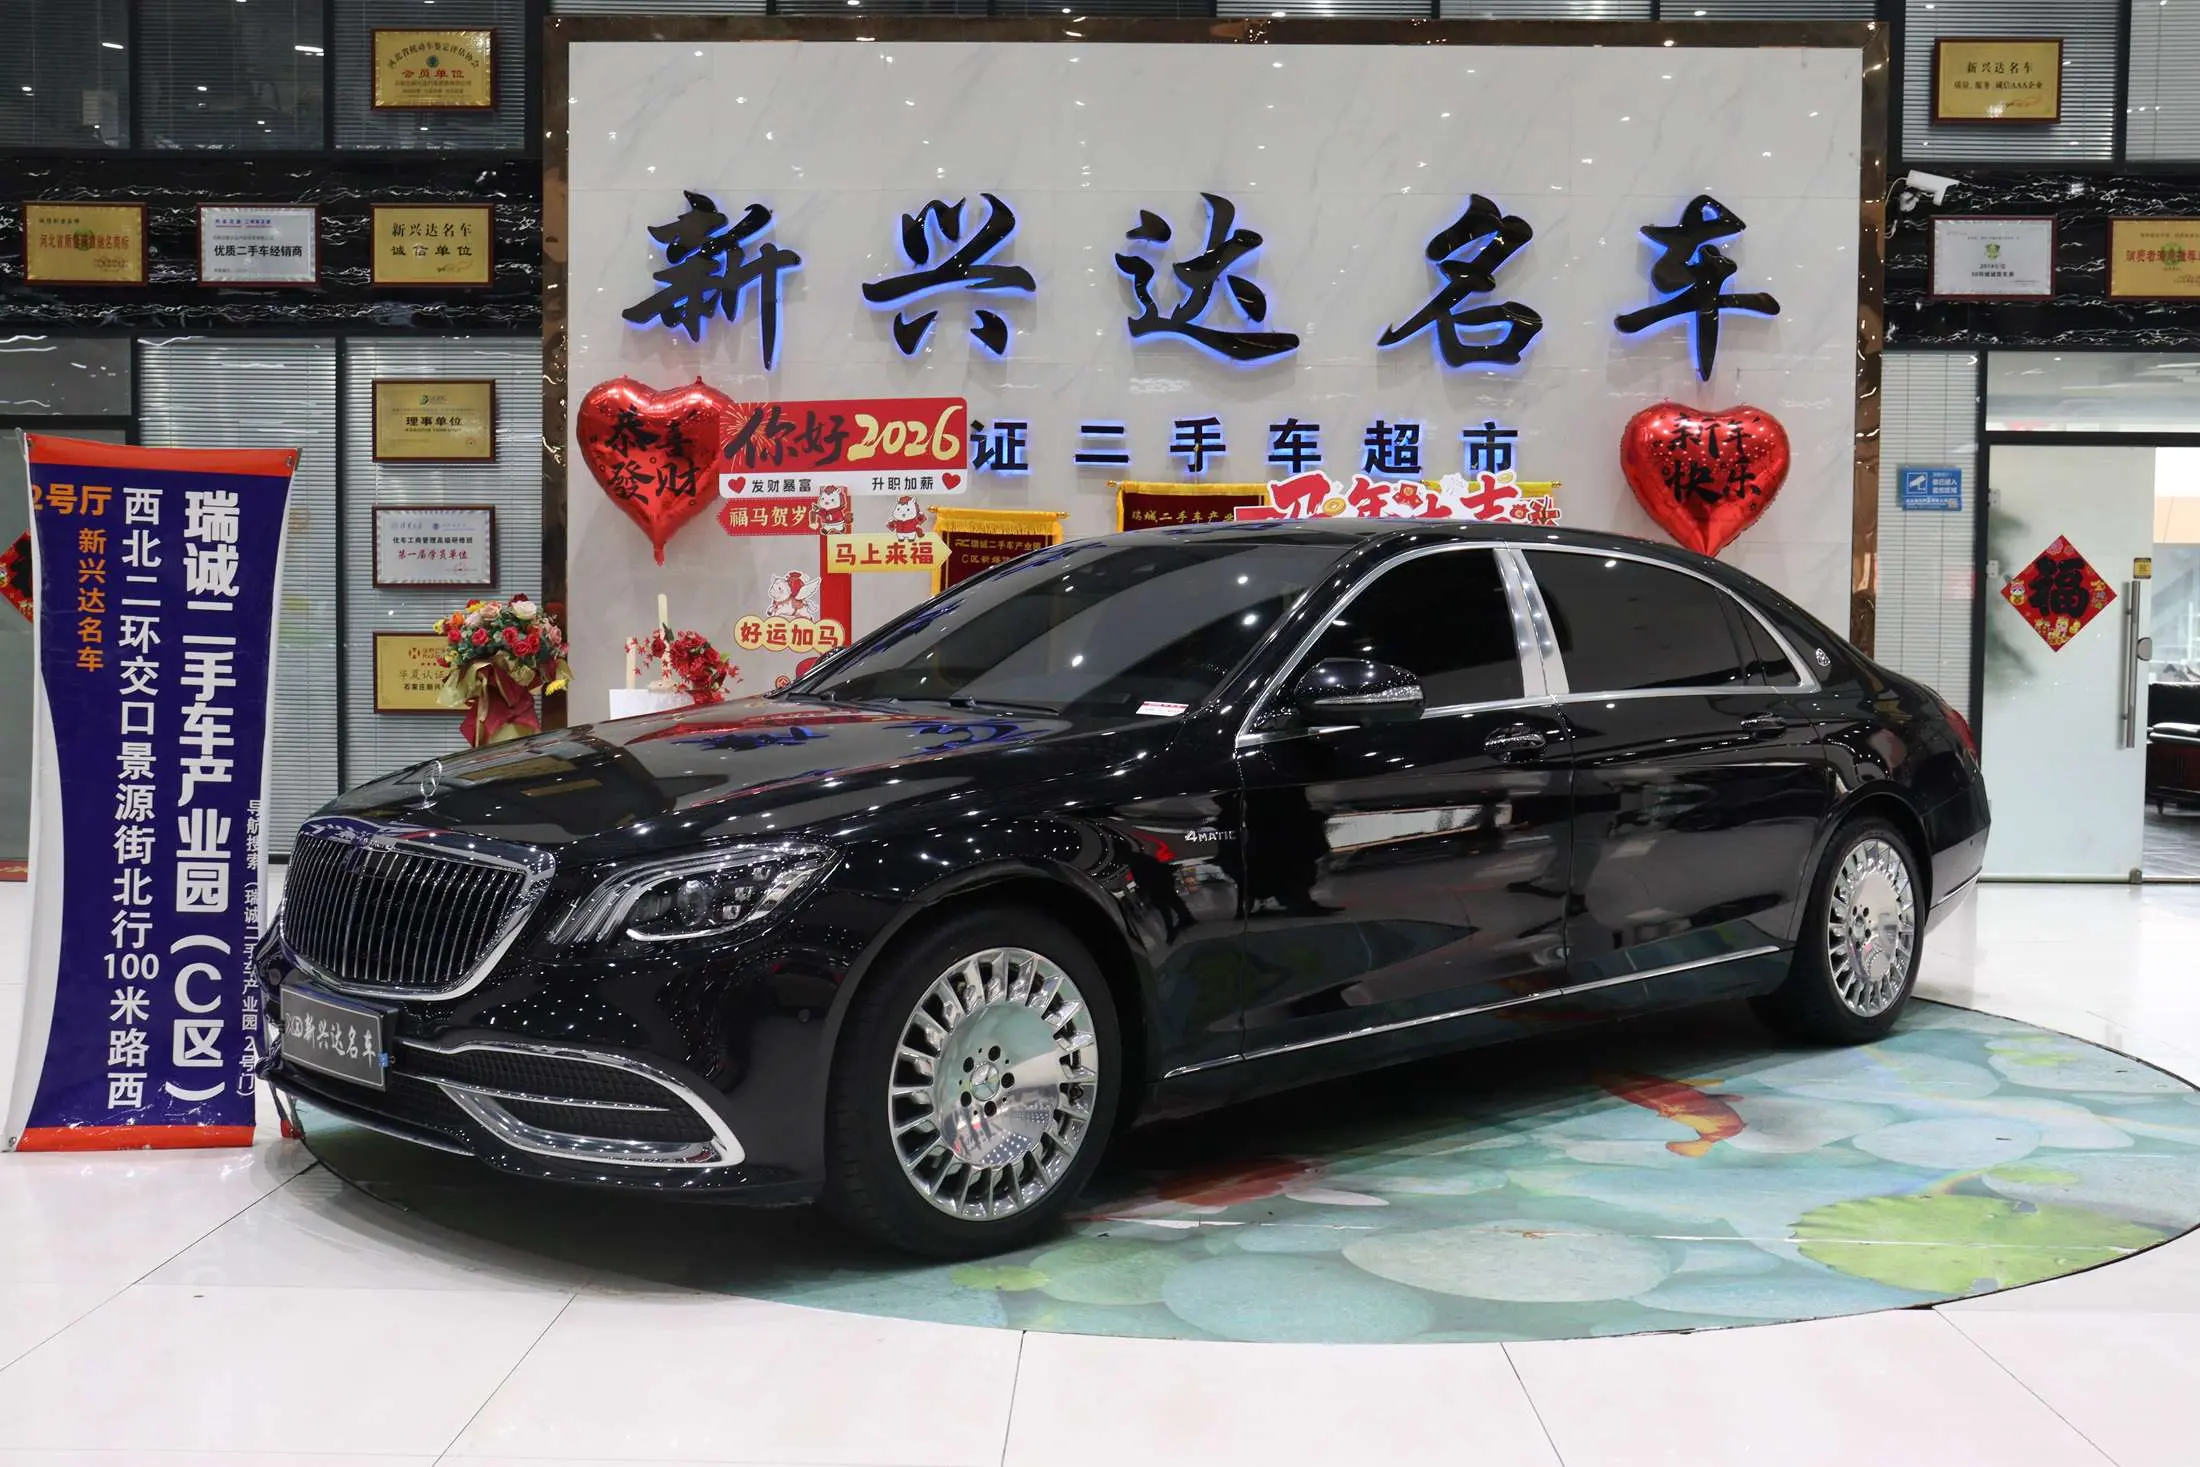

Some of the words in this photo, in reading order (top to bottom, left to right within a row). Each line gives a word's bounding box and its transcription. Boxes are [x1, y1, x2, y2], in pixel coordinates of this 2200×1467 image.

[401, 68, 464, 79] 会员单位
[1967, 61, 2033, 74] 新兴达名车
[391, 222, 472, 237] 新兴达名车
[214, 245, 302, 257] 优质二手车经销商
[391, 243, 472, 257] 诚信单位
[622, 190, 1780, 382] 新兴达名车
[406, 416, 461, 426] 理事单位
[604, 404, 692, 458] 恭喜
[1666, 421, 1753, 464] 新年
[752, 478, 812, 493] 发财暴富
[872, 475, 934, 491] 升职加薪
[1664, 456, 1761, 504] 快乐
[730, 506, 809, 527] 福马贺岁
[835, 542, 934, 566] 马上来福
[2028, 556, 2090, 618] 福
[77, 528, 108, 672] 新兴达名车
[740, 622, 838, 648] 好运加马
[104, 487, 163, 1110] 西北二环交口景源街北行100米路西
[1184, 830, 1237, 842] 4MATIC
[304, 1012, 376, 1069] 新兴达名车
